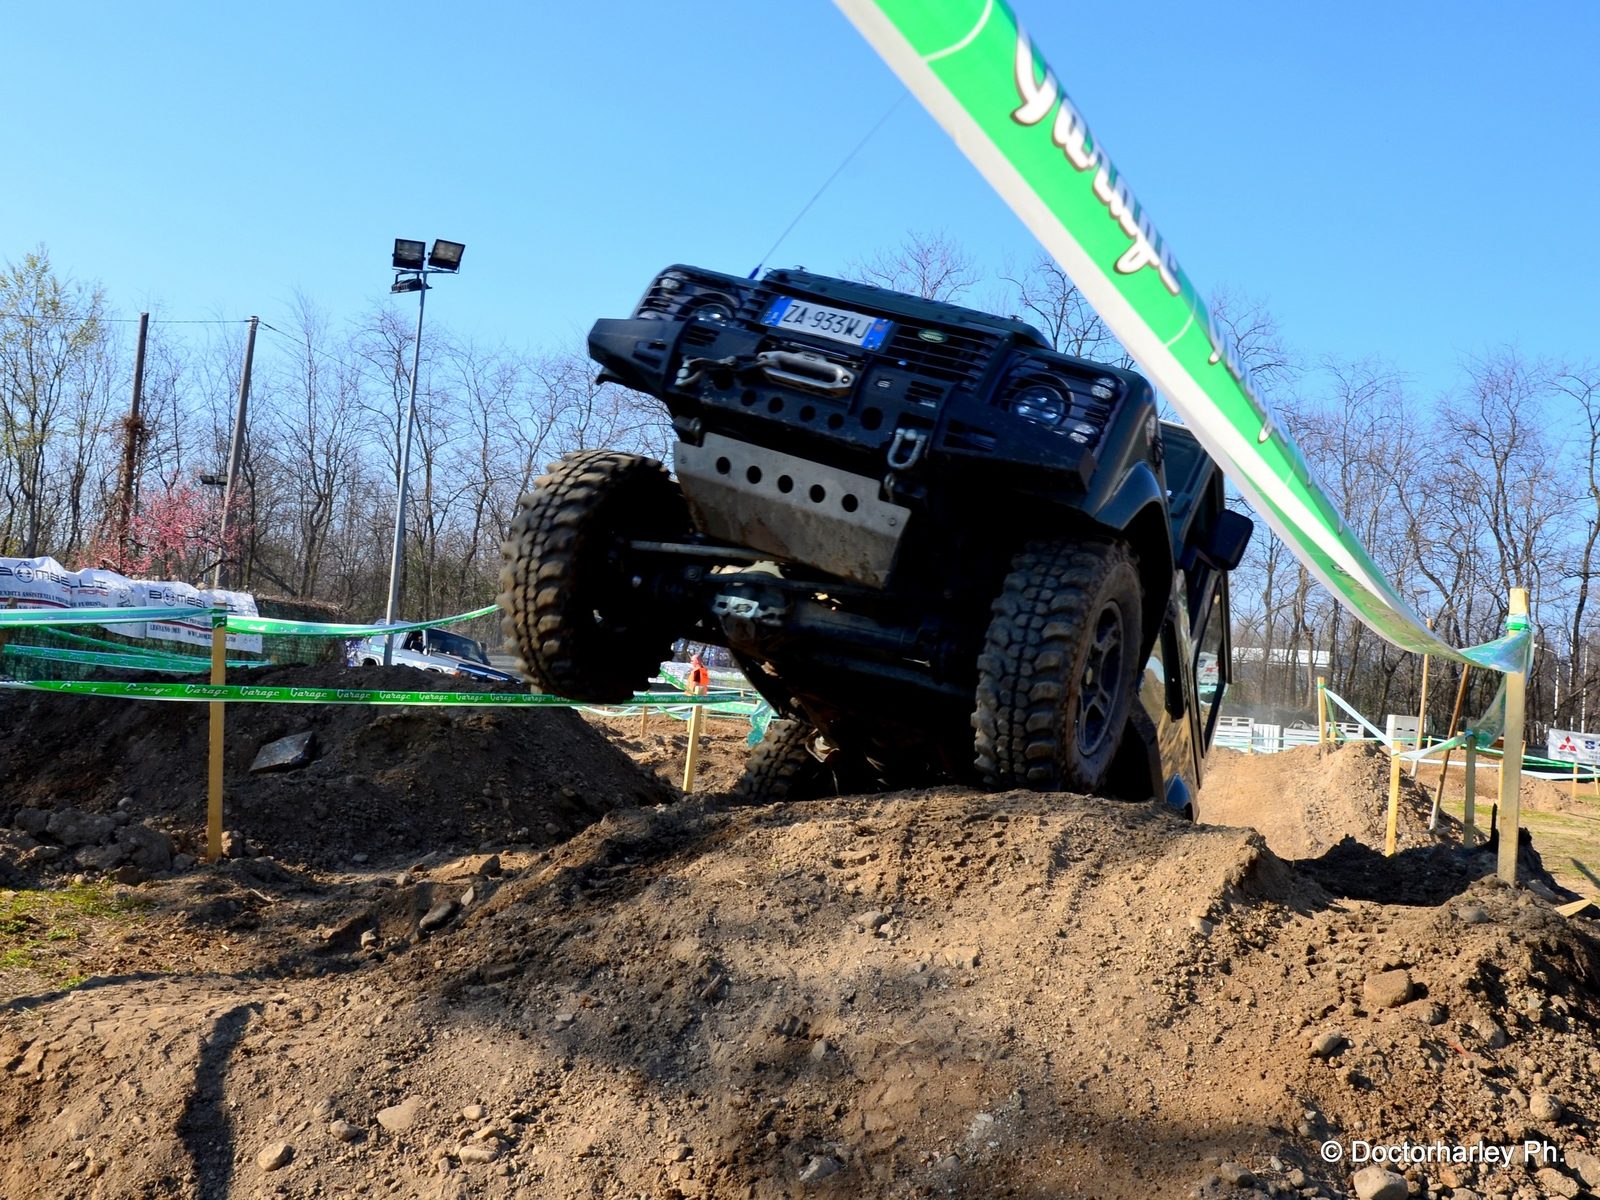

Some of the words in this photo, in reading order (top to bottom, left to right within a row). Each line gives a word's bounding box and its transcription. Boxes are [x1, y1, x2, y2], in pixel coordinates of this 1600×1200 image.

[184, 684, 228, 696] Garage
[239, 686, 280, 698] Garage
[290, 688, 328, 699] Garage
[336, 689, 371, 700] Garage
[379, 690, 411, 701] Garage
[419, 691, 449, 702] Garage
[455, 692, 485, 702] Garage
